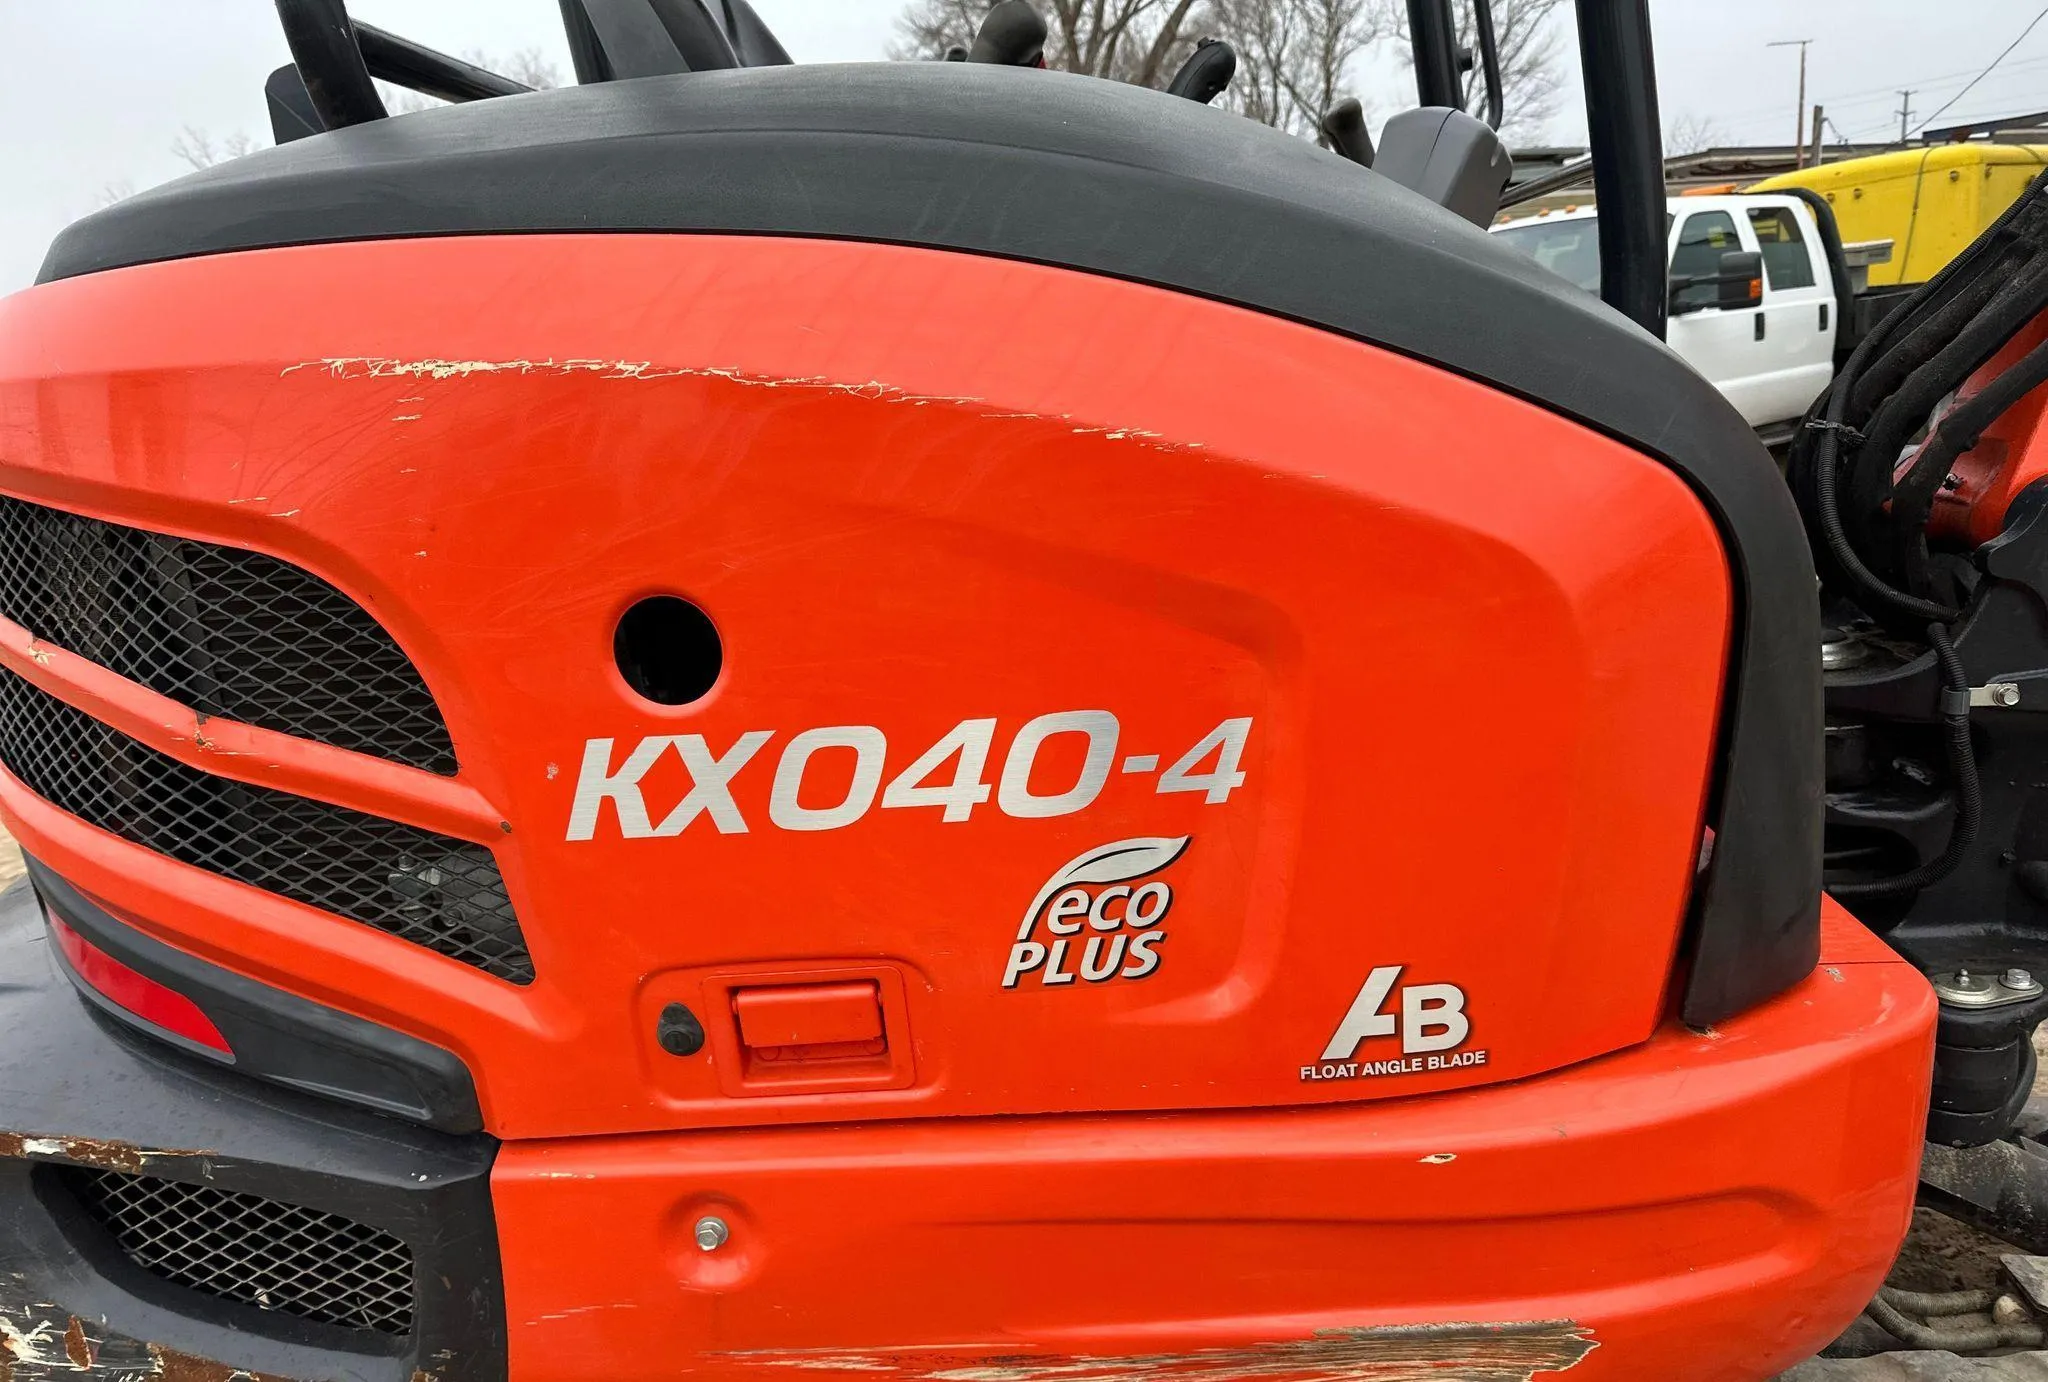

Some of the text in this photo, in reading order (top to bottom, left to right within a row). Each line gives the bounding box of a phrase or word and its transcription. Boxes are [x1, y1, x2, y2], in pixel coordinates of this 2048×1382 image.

[565, 709, 1254, 841] KX040-4
[1047, 881, 1172, 937] eco
[1001, 930, 1166, 989] PLUS
[1300, 1050, 1486, 1080] FLOAT ANGLE BLADE
